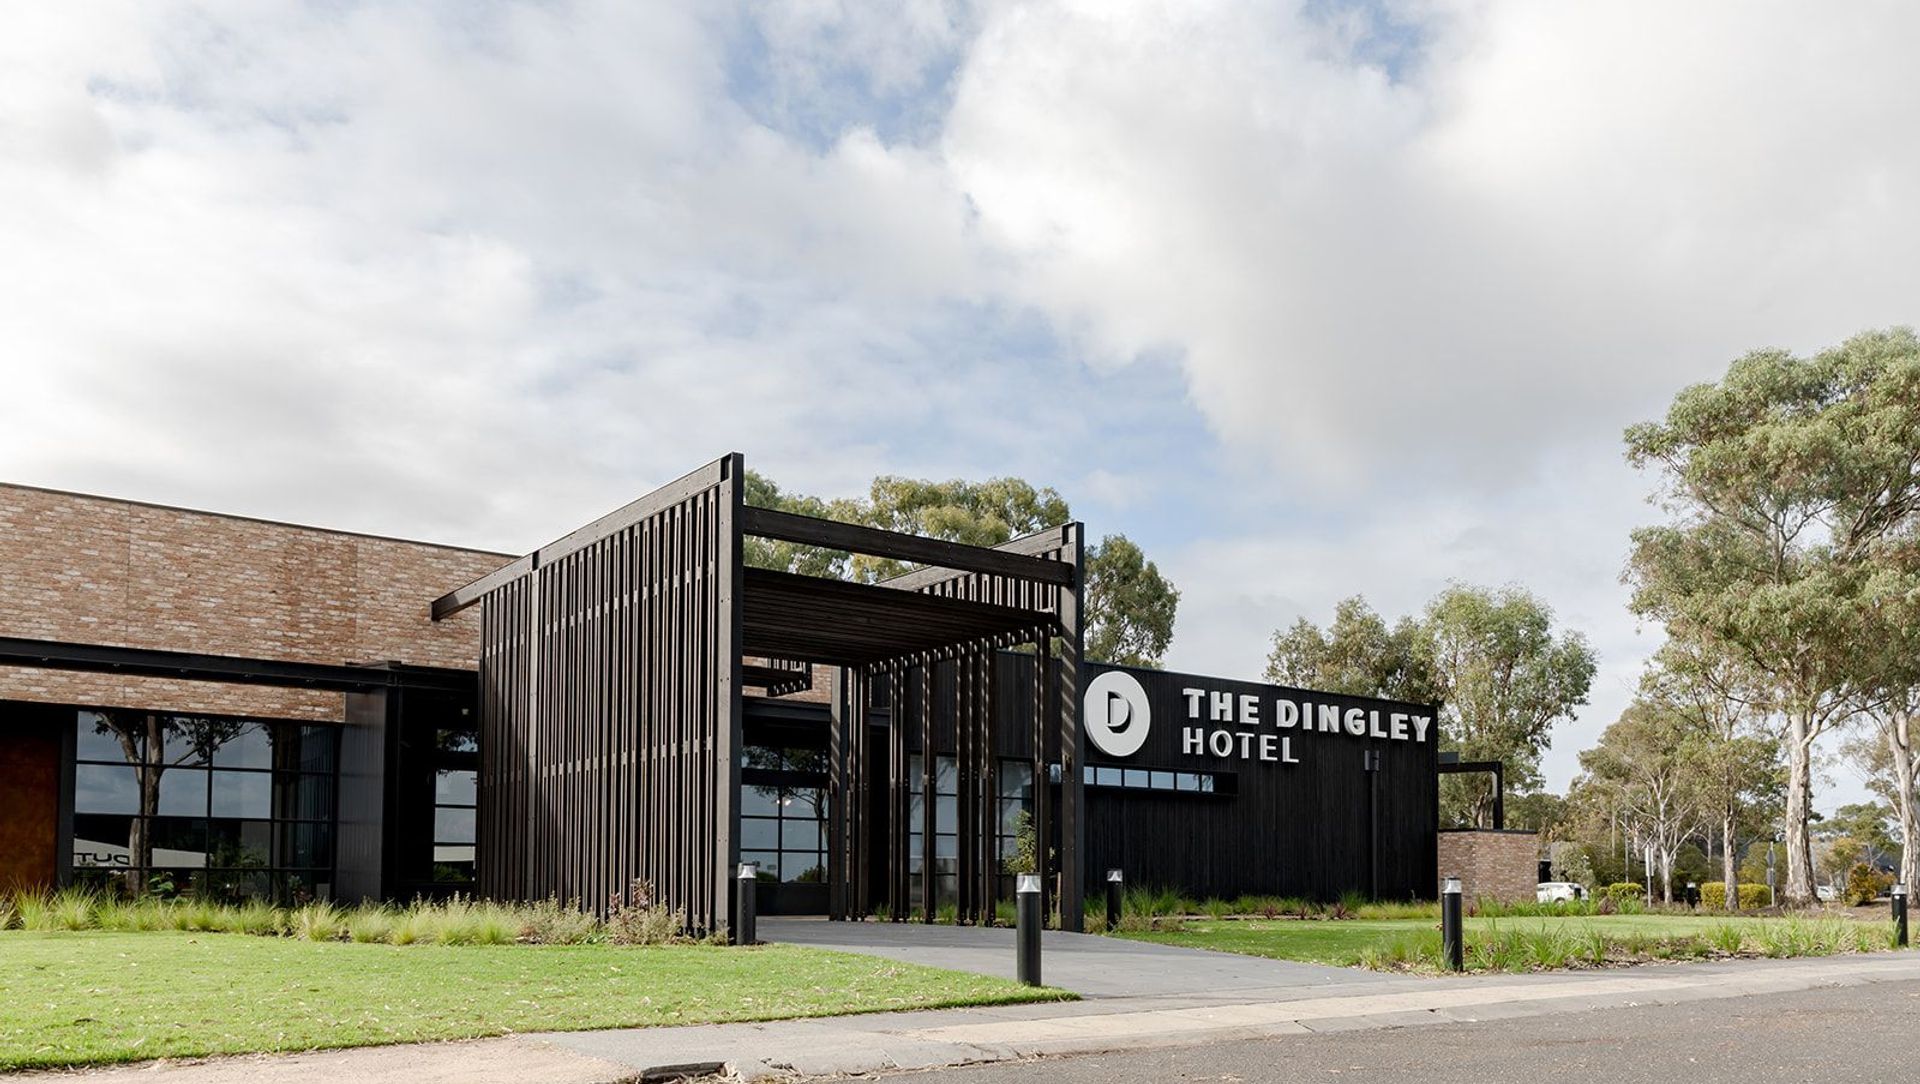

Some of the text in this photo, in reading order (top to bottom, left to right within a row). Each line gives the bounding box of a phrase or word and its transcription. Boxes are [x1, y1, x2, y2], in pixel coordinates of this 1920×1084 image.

[1182, 687, 1432, 742] THE DINGLEY
[1182, 727, 1300, 764] HOTEL
